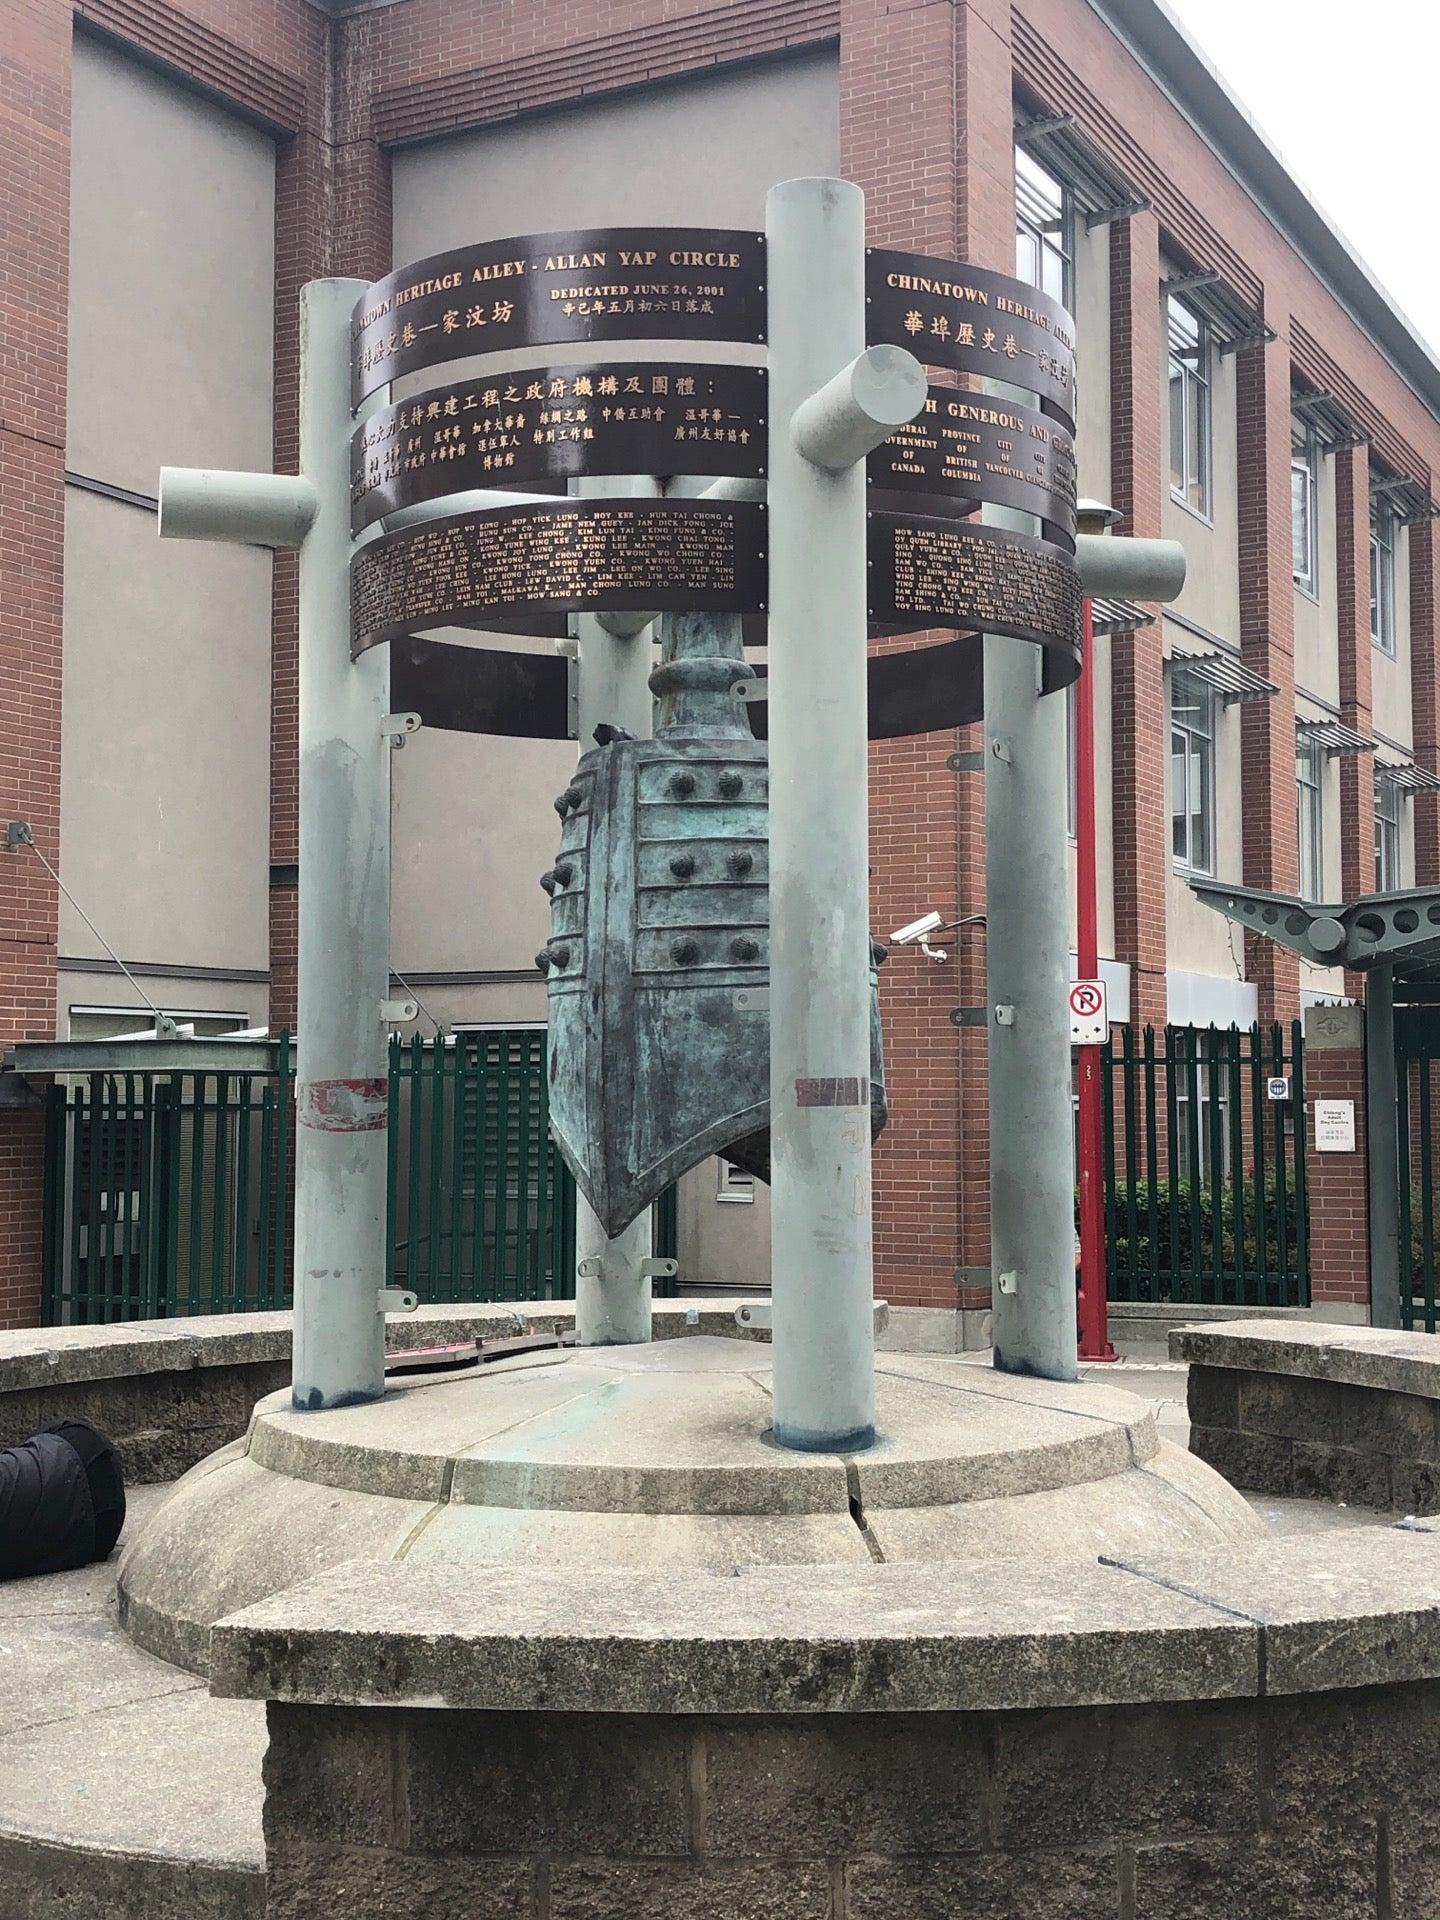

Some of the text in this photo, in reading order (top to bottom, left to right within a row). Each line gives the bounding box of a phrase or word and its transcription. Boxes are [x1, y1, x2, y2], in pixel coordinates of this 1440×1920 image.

[396, 272, 462, 307] HERITAGE
[472, 260, 526, 282] ALLEY
[544, 252, 606, 271] ALLAN
[618, 251, 657, 266] YAP
[669, 251, 740, 268] CIRCLE
[551, 285, 725, 300] DEDICATED JUNE 26, 2001
[887, 272, 988, 306] CHINATOWN
[996, 295, 1051, 332] HERITAGE
[900, 424, 928, 435] DERAL
[947, 403, 1024, 433] GENEROUS
[1029, 424, 1049, 445] AND
[885, 436, 938, 450] OVERNMENT
[941, 429, 982, 444] PROVINCE
[956, 445, 968, 453] OF
[996, 439, 1014, 451] CITY
[902, 450, 915, 460] OF
[945, 455, 978, 468] BRITISH
[891, 462, 926, 474] CANADA
[941, 468, 982, 482] COLUMBIA
[985, 462, 1024, 480] VANCOUVER
